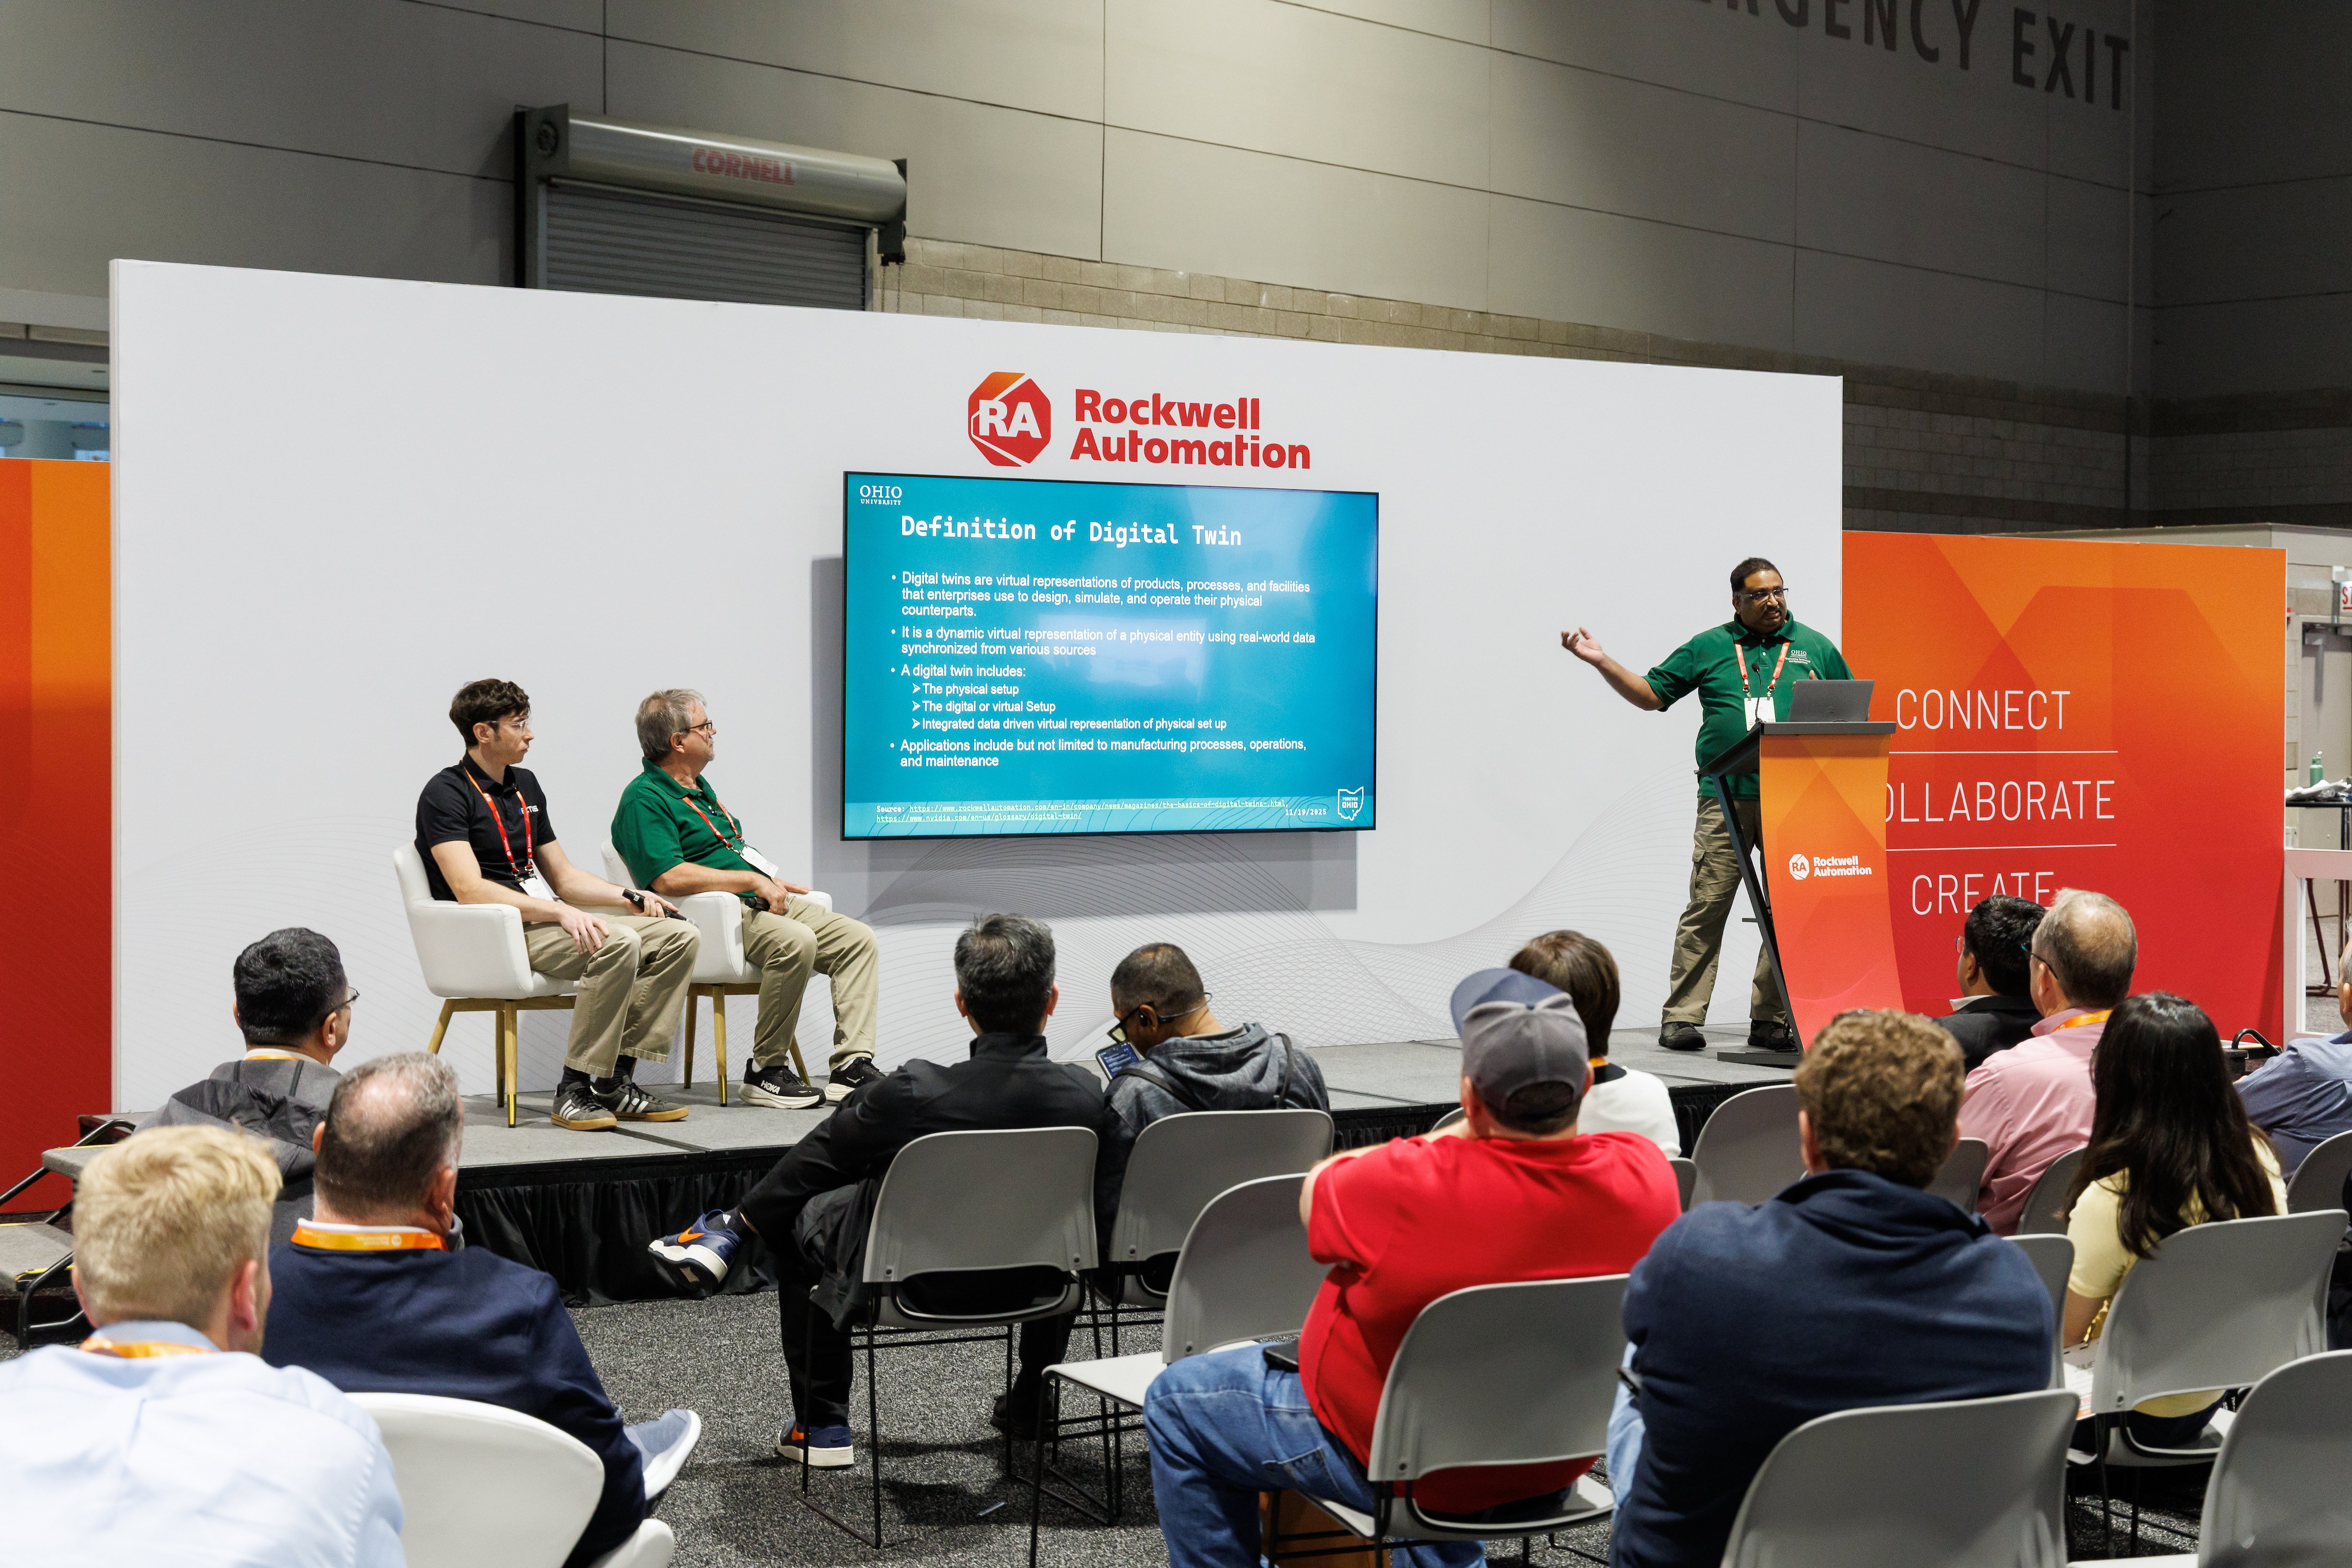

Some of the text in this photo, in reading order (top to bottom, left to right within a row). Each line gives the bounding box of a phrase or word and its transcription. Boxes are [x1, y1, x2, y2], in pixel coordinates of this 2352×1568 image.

[2012, 7, 2130, 111] EXIT
[692, 149, 795, 185] CORNELL
[1076, 389, 1260, 430] Rockwell
[979, 400, 1041, 439] RA
[1070, 427, 1311, 469] Automation
[859, 485, 902, 499] OHIO
[902, 515, 1241, 548] Definition of Digital Twin
[902, 571, 1310, 593] Digital twins are virtual representations of products, processes, and facilities
[902, 587, 1262, 609] that enterprises use to design, simulate, and operate their physical
[902, 604, 977, 619] counterparts.
[902, 625, 1315, 645] It is a dynamic virtual representation of a physical entity using real-world data
[901, 641, 1097, 657] synchronized from various sources
[901, 663, 1026, 680] A digital twin includes:
[922, 683, 1019, 697] The physical setup
[922, 700, 1056, 714] The digital or virtual Setup
[1897, 688, 2071, 730] CONNECT
[922, 717, 1227, 732] Integrated data driven virtual representation of physical set up
[900, 737, 1306, 755] Applications include but not limited to manufacturing processes, operations,
[900, 754, 999, 767] and maintenance
[1885, 780, 2115, 823] LLABORATE
[1792, 862, 1807, 872] RA
[1813, 855, 1859, 867] Rockwell
[1813, 865, 1872, 877] Automation
[1912, 871, 2054, 915] CREATE
[760, 1079, 781, 1094] HOKA
